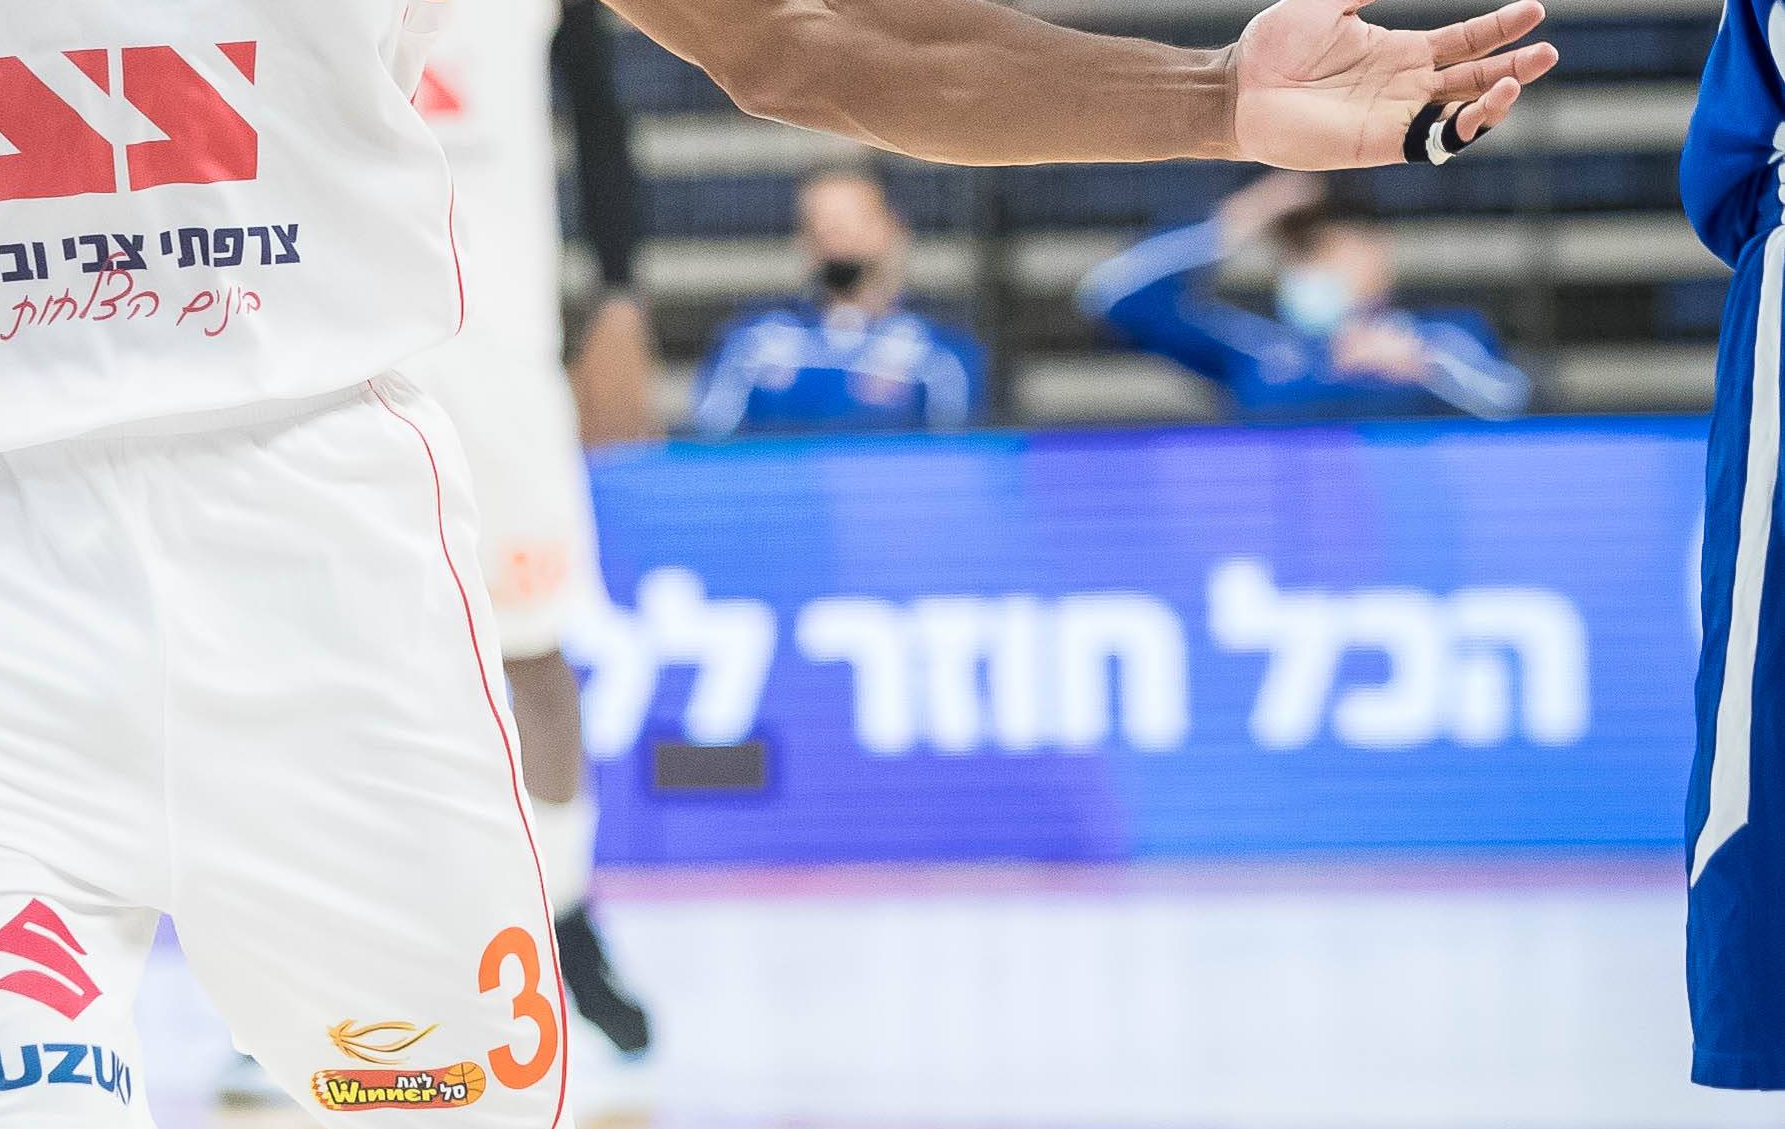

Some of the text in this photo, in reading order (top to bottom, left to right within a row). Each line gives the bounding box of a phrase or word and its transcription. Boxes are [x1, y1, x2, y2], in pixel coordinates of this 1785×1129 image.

[62, 233, 148, 274] צבי
[159, 223, 301, 268] צרפתי
[796, 589, 1191, 755] חוזר
[1209, 554, 1589, 750] הכל
[478, 926, 559, 1090] 3
[327, 1079, 438, 1104] Winner
[395, 1072, 434, 1089] ליגת
[438, 1082, 468, 1102] סל
